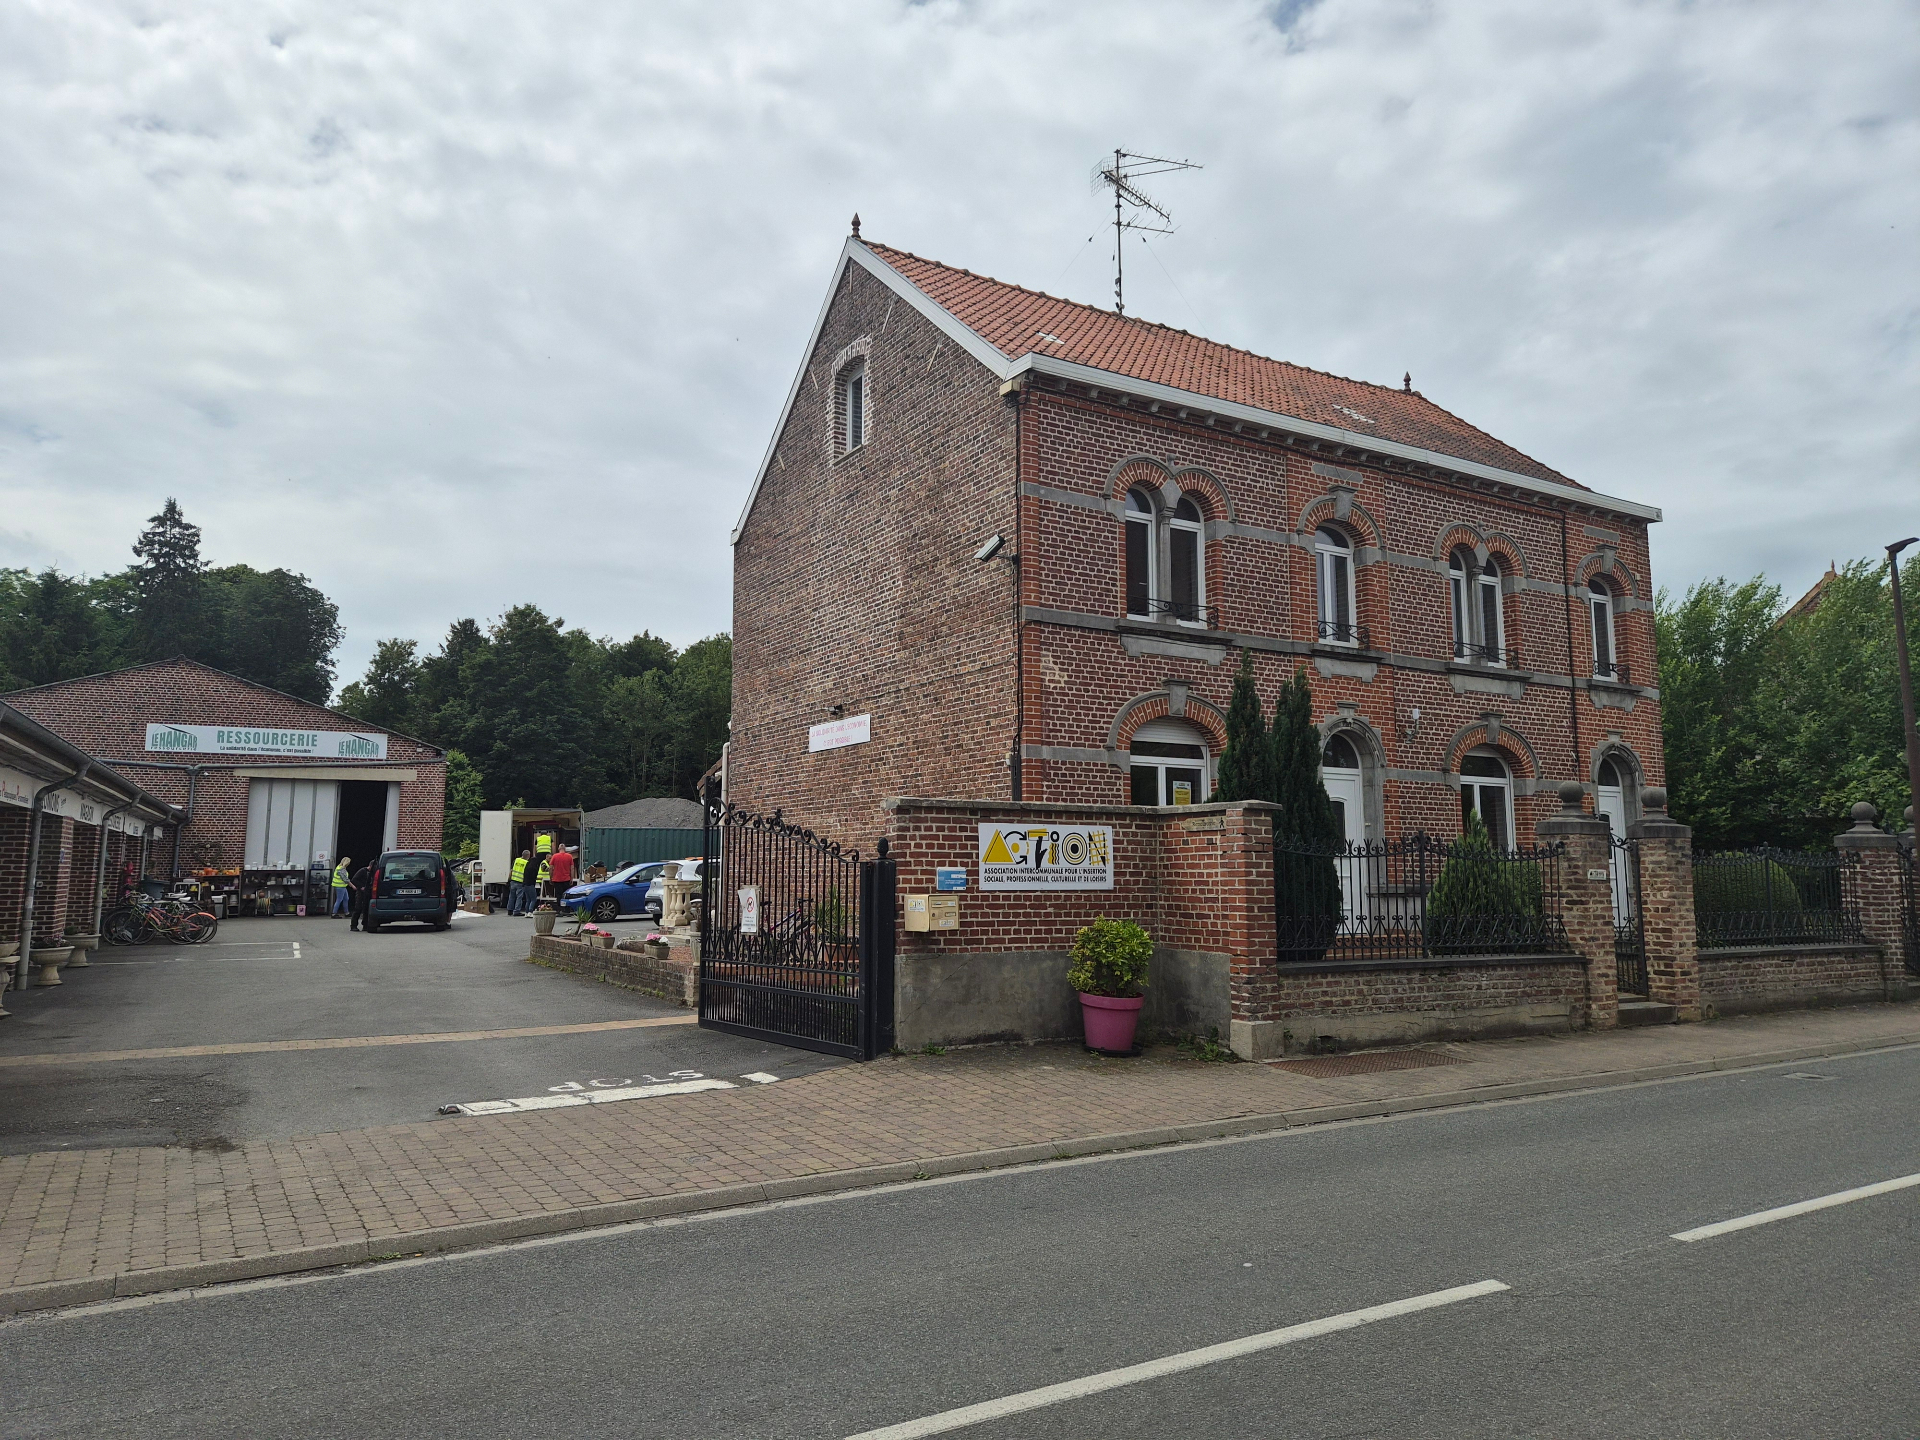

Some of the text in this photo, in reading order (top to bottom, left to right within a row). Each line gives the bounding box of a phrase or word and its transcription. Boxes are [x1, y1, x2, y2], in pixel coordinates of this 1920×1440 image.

[151, 730, 198, 749] LE HANGAR
[217, 730, 318, 747] RESSOURCERIE
[338, 738, 380, 756] LE HANGAR
[984, 875, 1006, 883] SOCIALE,
[1006, 875, 1050, 883] PROFESSIONNELLE,
[1050, 875, 1077, 883] CULTURELLE
